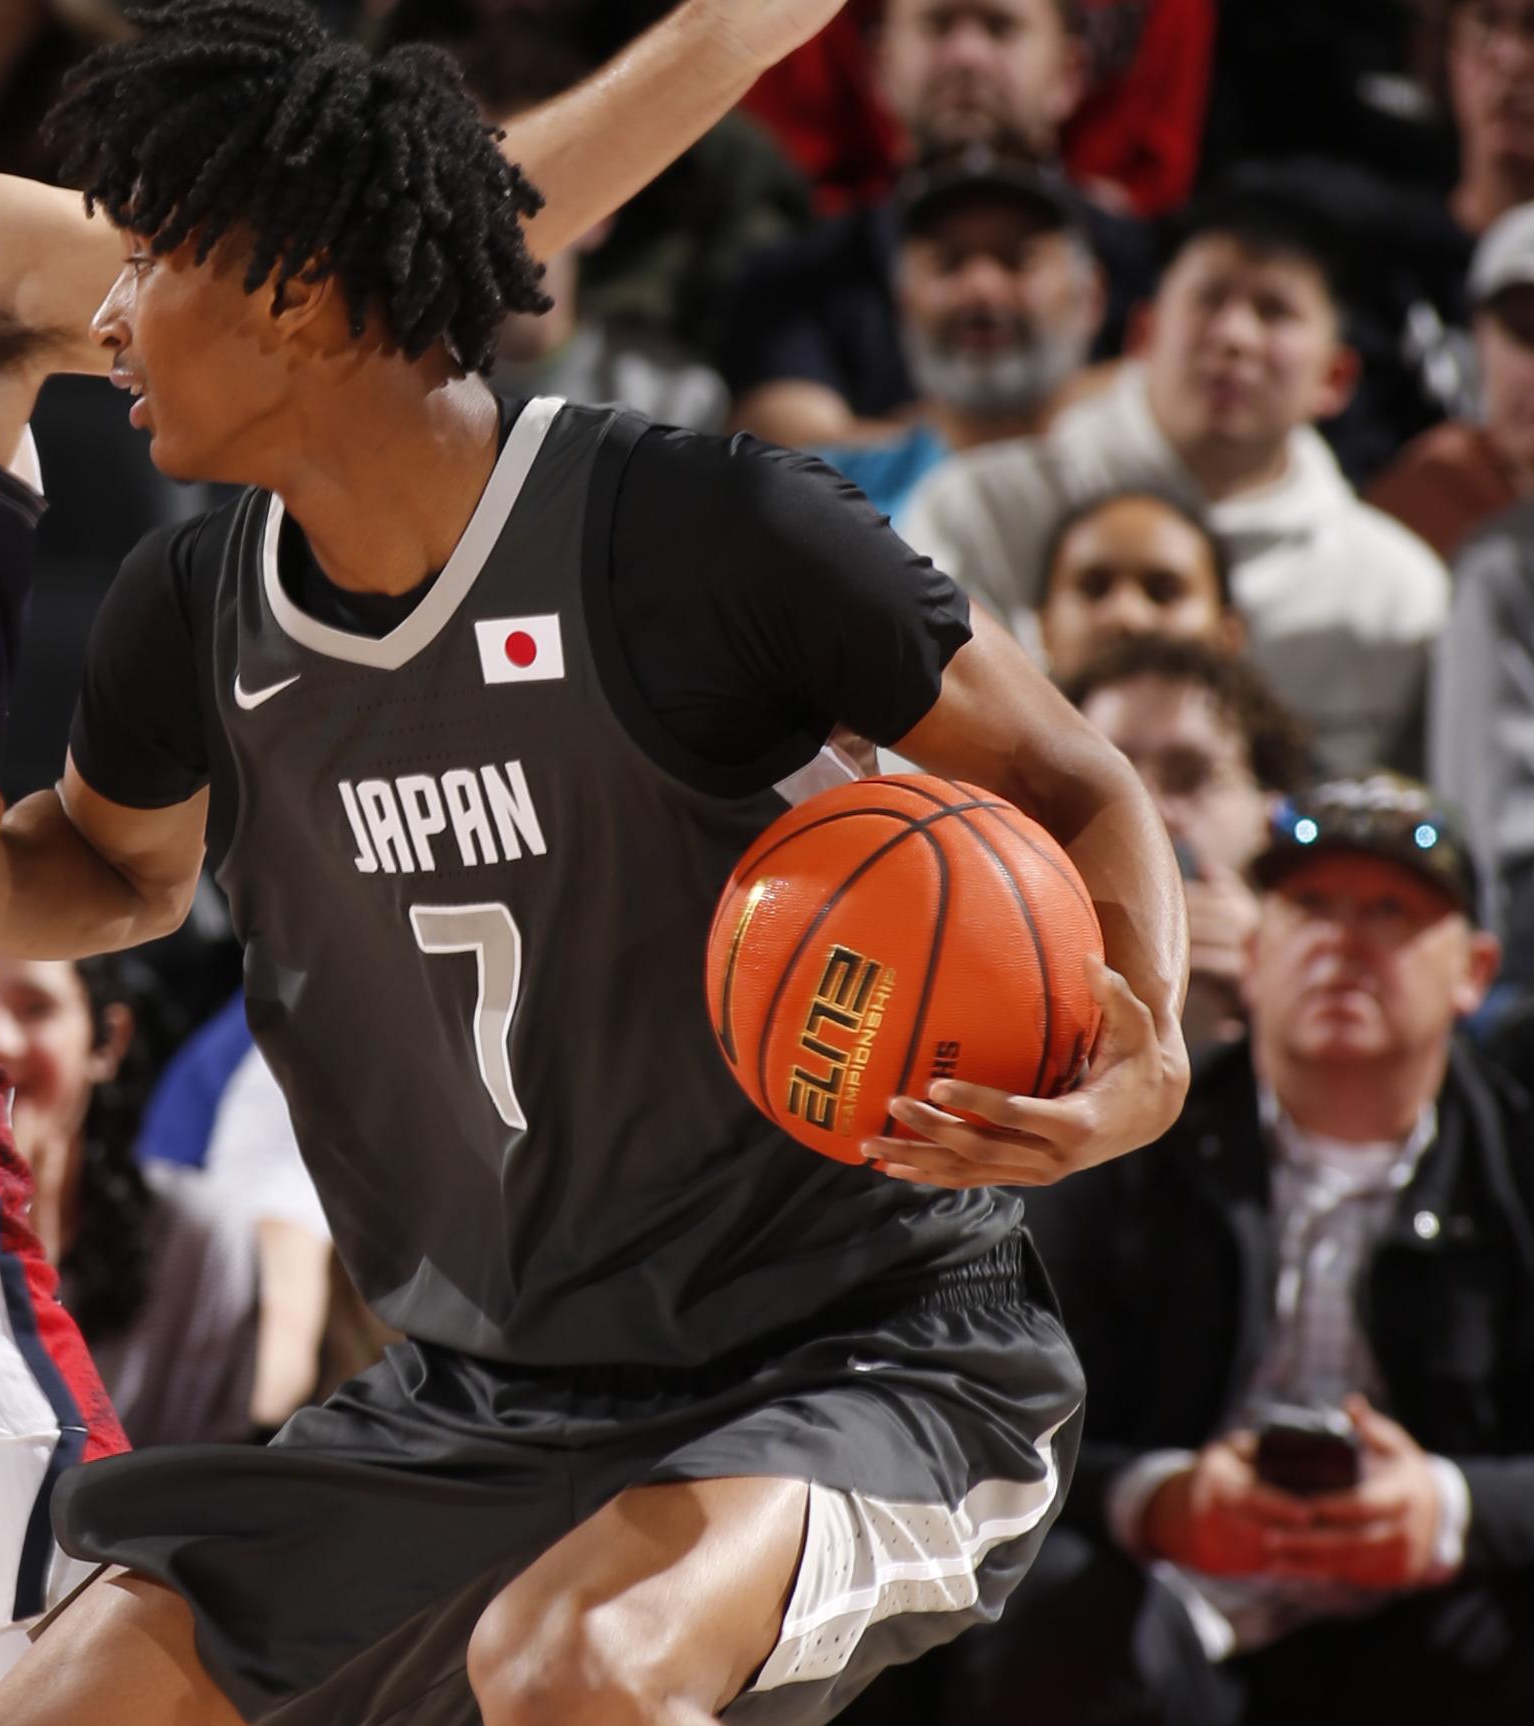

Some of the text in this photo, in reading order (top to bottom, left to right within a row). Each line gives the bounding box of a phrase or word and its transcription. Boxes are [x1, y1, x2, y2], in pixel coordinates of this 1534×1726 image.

[338, 759, 547, 874] JAPAN
[409, 902, 527, 1131] 7
[788, 944, 883, 1132] ELITE
[929, 1040, 962, 1079] HS
